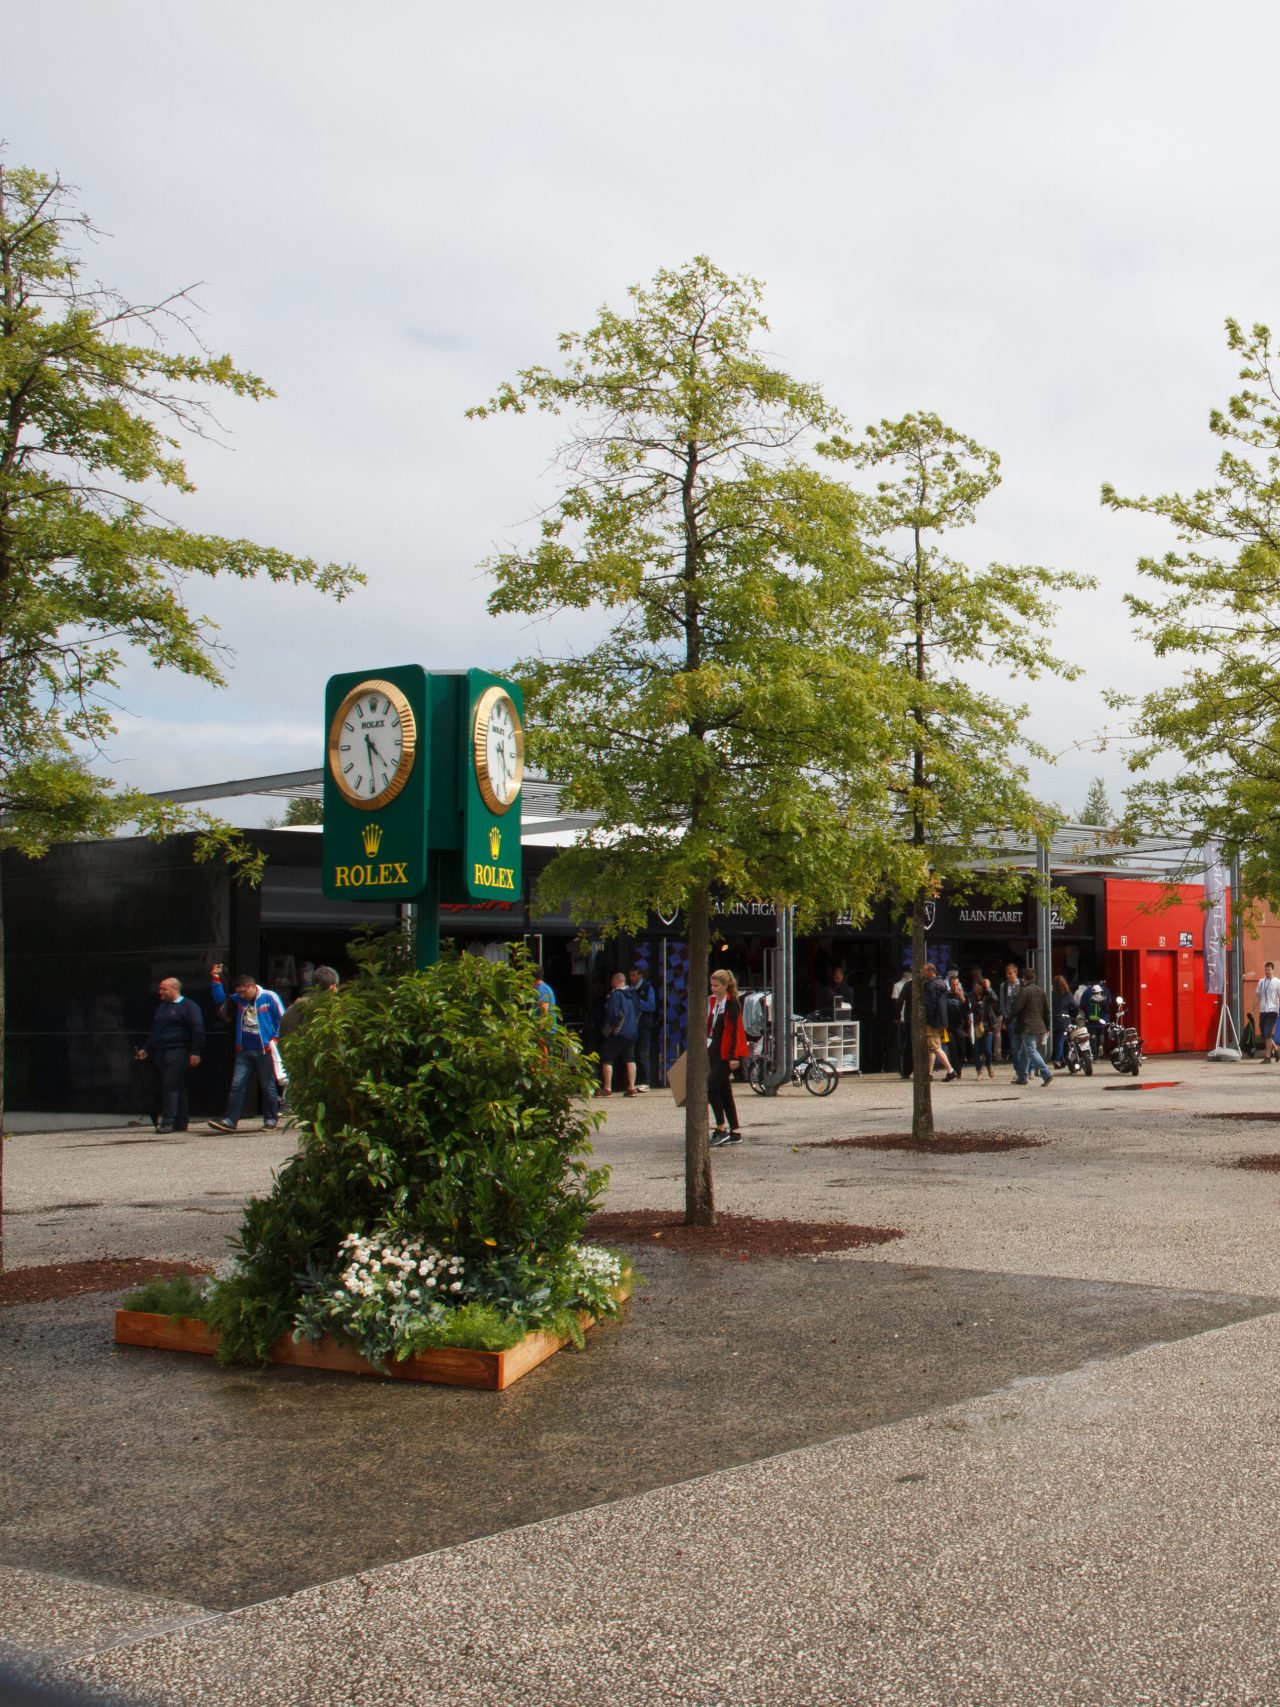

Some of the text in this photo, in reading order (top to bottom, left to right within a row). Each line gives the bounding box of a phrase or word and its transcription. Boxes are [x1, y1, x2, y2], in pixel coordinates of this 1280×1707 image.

[361, 719, 385, 730] ROLEX
[335, 863, 409, 887] ROLEX
[474, 863, 515, 890] ROLEX
[752, 904, 798, 916] FIGAT
[959, 910, 1023, 923] ALAIN FIGARET
